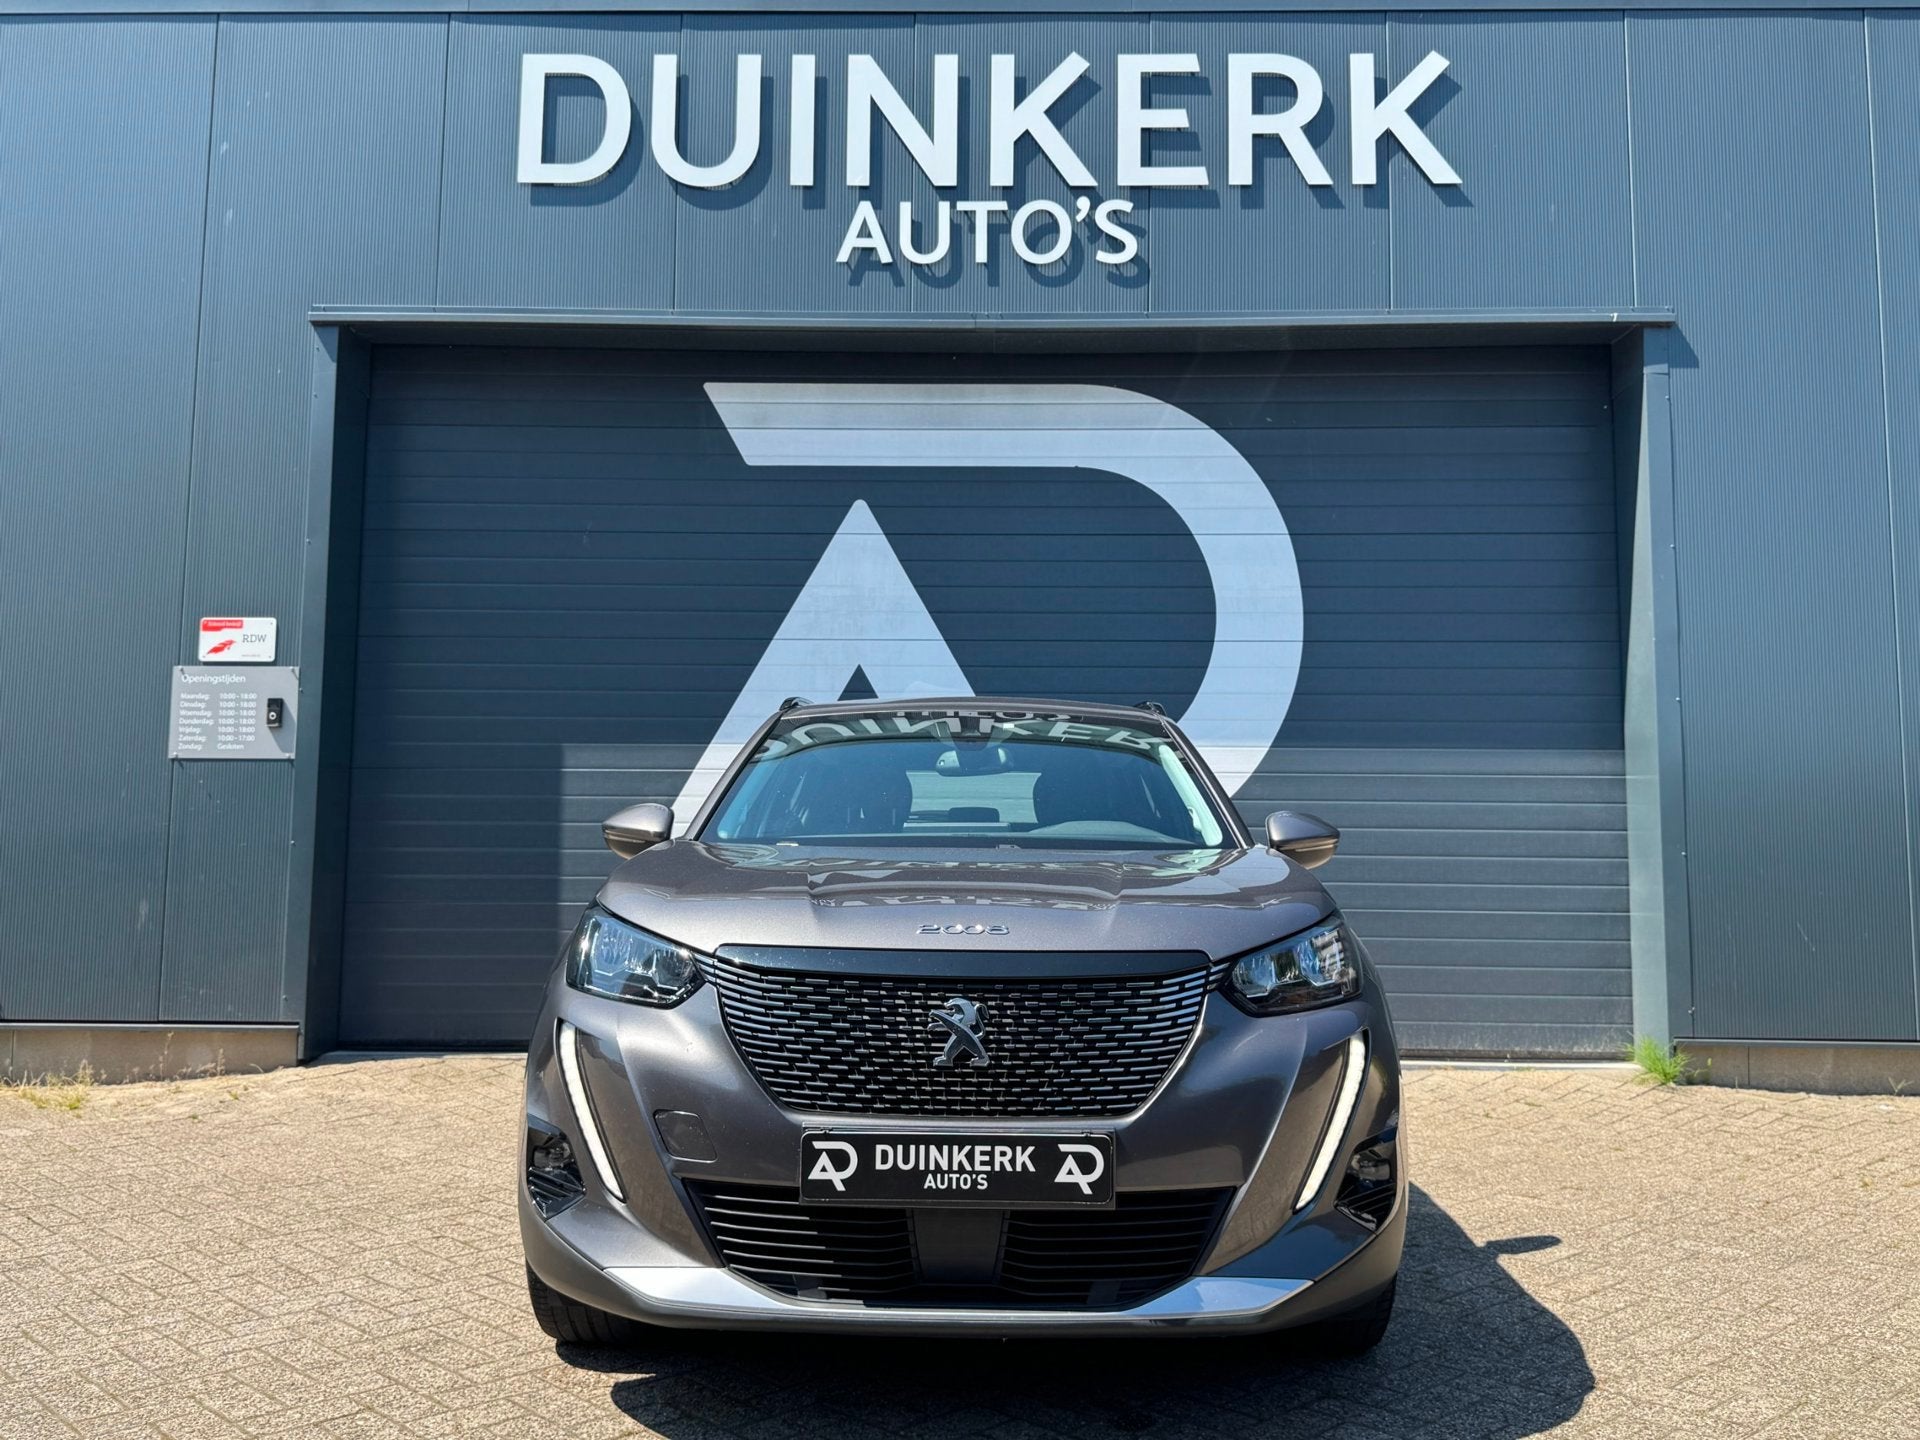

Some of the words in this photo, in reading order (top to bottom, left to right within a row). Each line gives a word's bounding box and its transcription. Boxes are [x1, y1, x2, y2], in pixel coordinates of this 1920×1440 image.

[517, 50, 1463, 188] DUINKERK
[836, 196, 1138, 265] AUTO'S
[242, 634, 267, 644] RDW
[181, 674, 246, 684] Openingstijden
[916, 924, 1010, 935] 2008
[875, 1144, 1036, 1172] DUINKERK
[924, 1174, 988, 1189] AUTO'S
